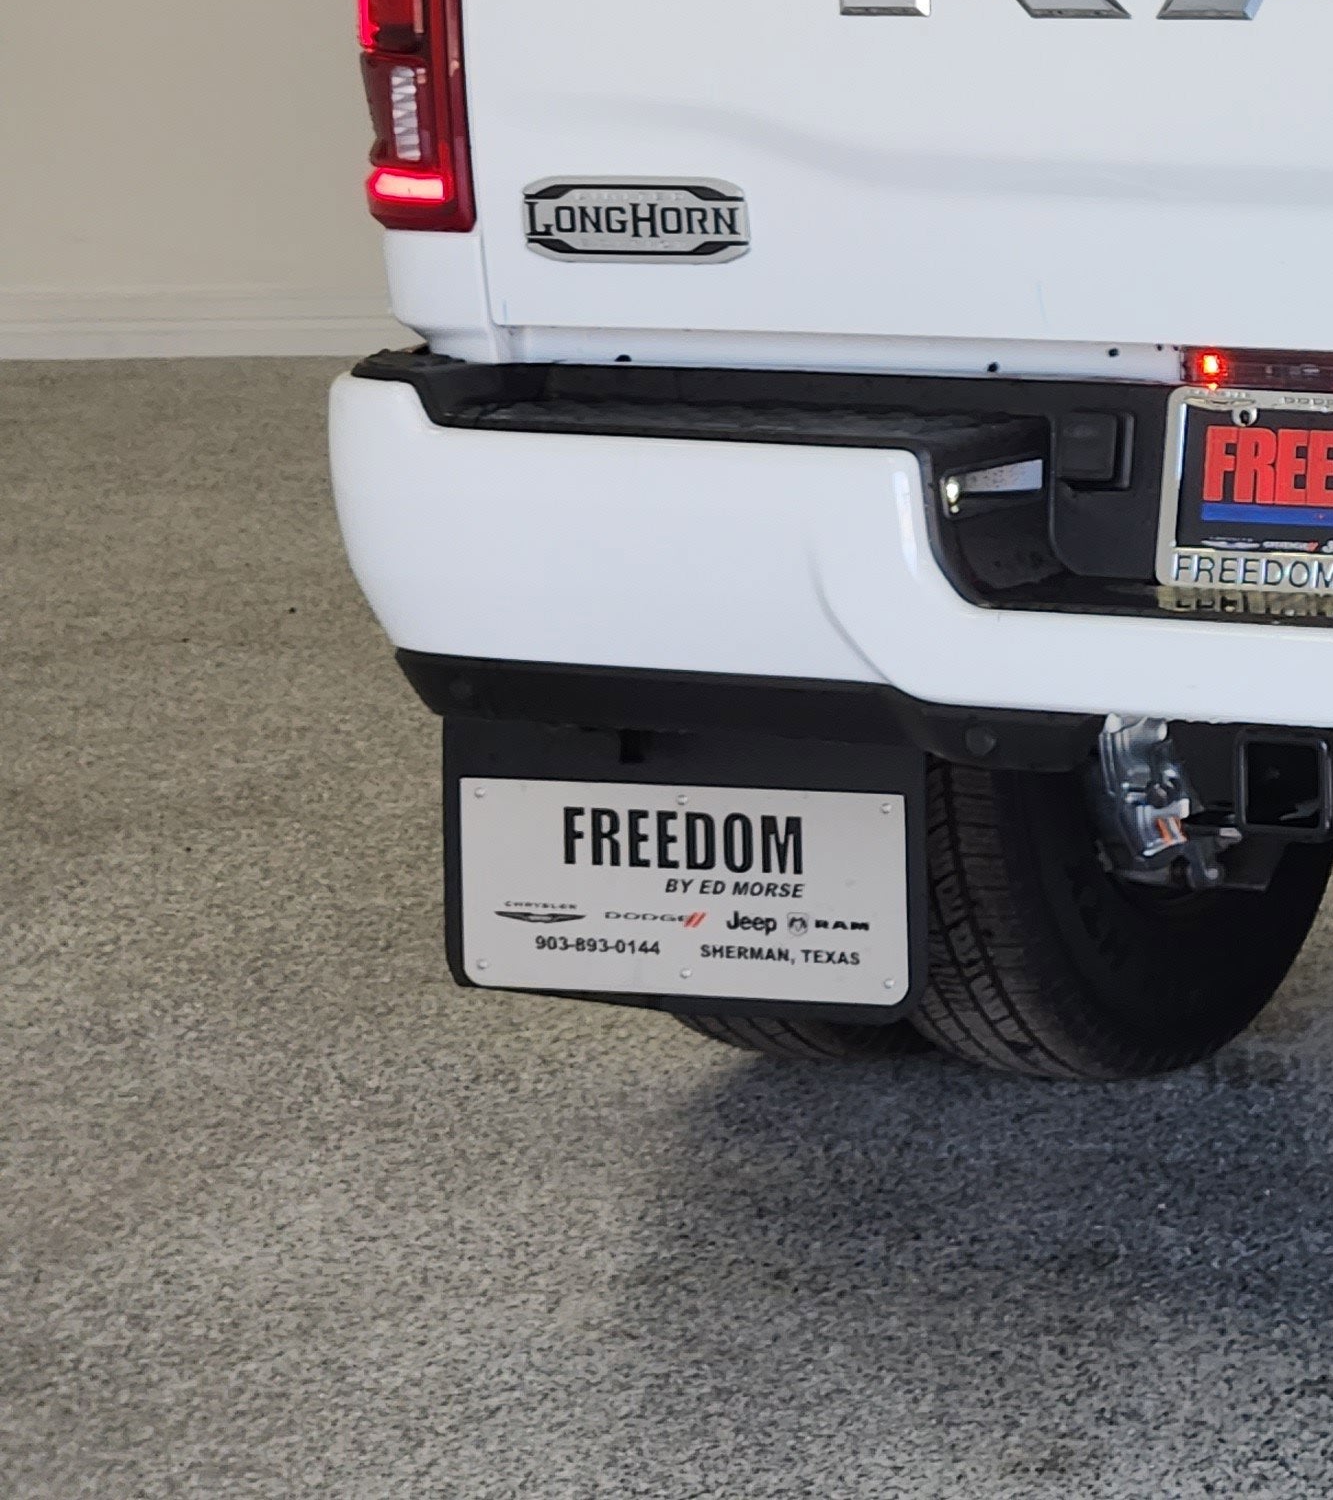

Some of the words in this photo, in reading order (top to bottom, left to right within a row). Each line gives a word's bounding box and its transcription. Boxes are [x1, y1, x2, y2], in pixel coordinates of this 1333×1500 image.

[563, 806, 804, 875] FREEDOM
[665, 878, 695, 894] BY
[699, 879, 726, 895] ED
[732, 882, 806, 898] MORSE
[726, 911, 778, 936] Jeep
[814, 919, 870, 932] RAM
[535, 935, 661, 955] 903-893-0144
[700, 944, 796, 965] SHERMAN,
[802, 949, 860, 966] TEXAS
